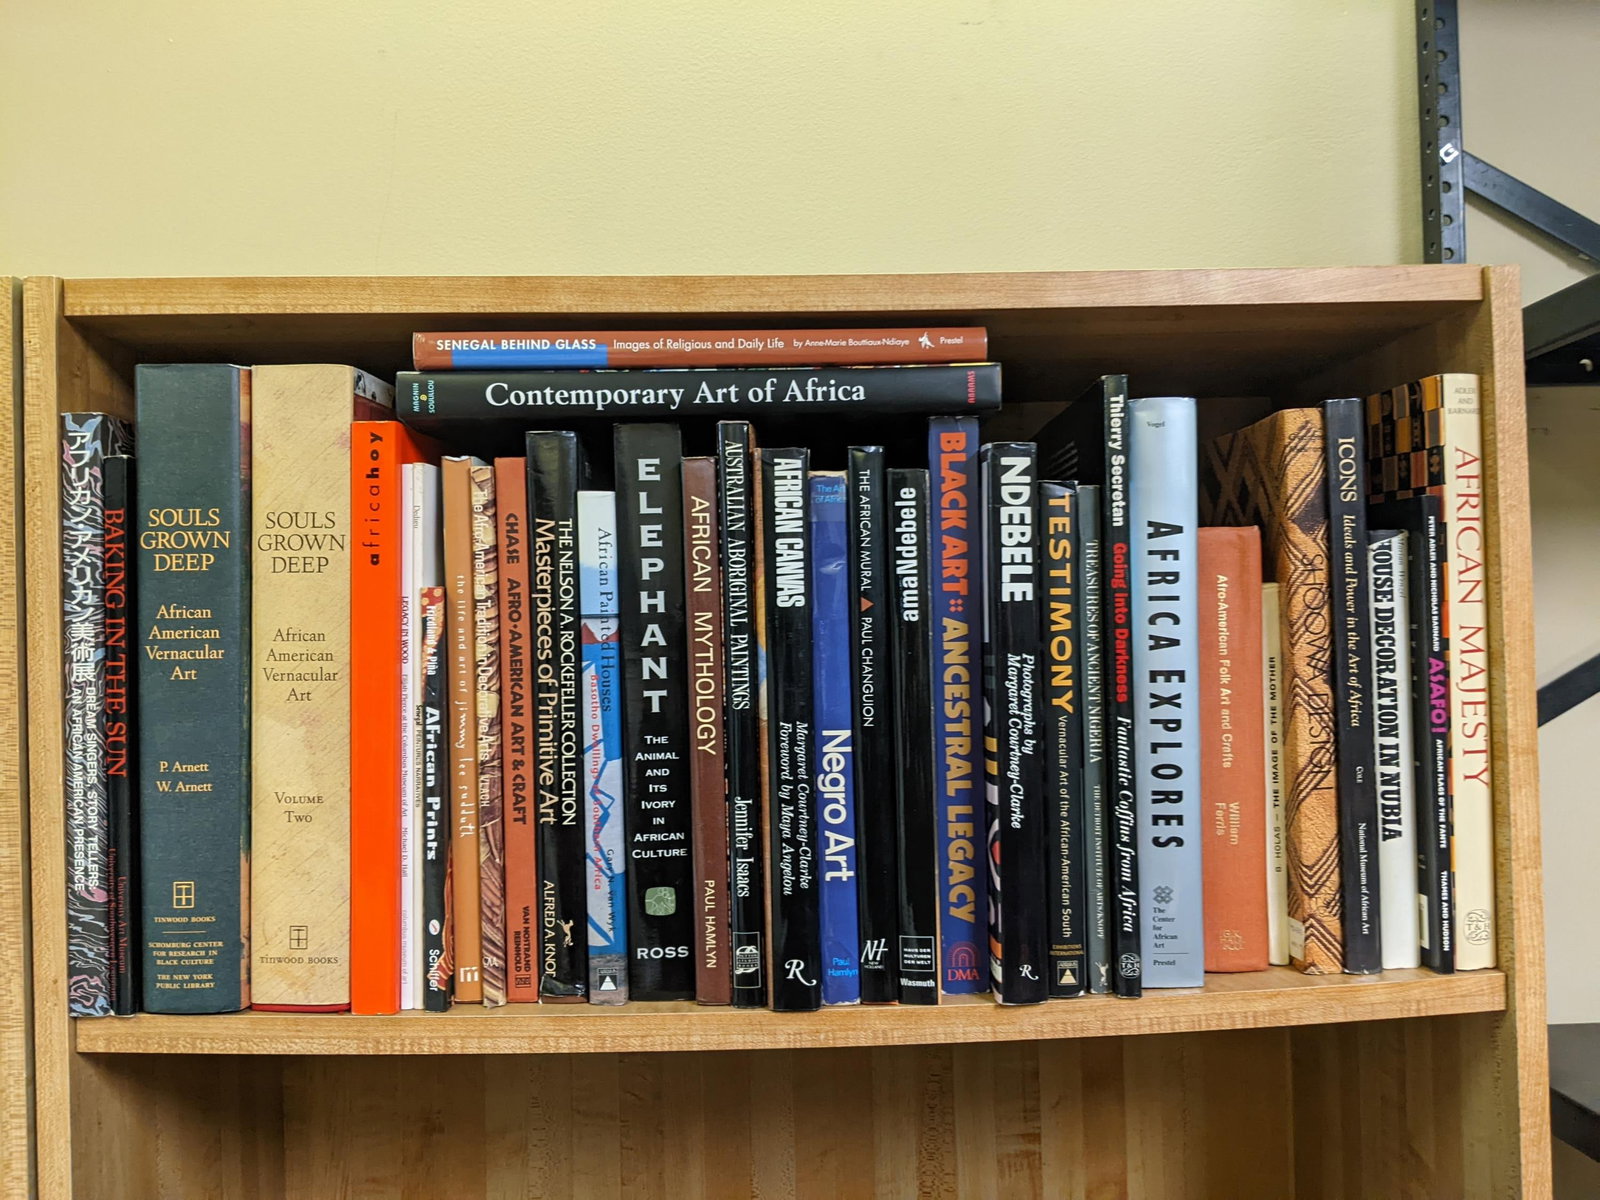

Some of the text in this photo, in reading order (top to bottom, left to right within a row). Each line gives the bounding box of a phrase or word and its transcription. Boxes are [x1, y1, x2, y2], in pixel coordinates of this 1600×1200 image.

[436, 339, 596, 350] SENEGAL BEHIND GLASS
[613, 337, 785, 352] Images of Religious and Daily Life
[793, 337, 910, 348] by Anne-Marie Bouttiaux-Ndiaye
[939, 336, 963, 345] Prestel
[412, 382, 420, 413] MAGNIN
[428, 379, 436, 414] SOULILLOU
[485, 377, 866, 410] Contemporary Art of Africa
[941, 431, 967, 531] BLACK
[1108, 394, 1127, 527] Thierry Secretan
[1338, 437, 1357, 503] ICONS
[148, 508, 220, 527] SOULS
[265, 511, 336, 529] SOULS
[362, 430, 384, 567] africahoy
[140, 531, 231, 549] GROWN
[257, 534, 346, 552] GROWN
[505, 512, 519, 565] CHASE
[773, 457, 806, 607] AFRICAN CANVAS
[859, 468, 872, 591] THE AFRICAN MURAL
[999, 456, 1033, 602] NDEBELE
[1455, 445, 1483, 604] AFRICAN
[154, 553, 215, 572] DEEP
[271, 556, 329, 574] DEEP
[725, 440, 751, 710] AUSTRALIAN ABORIGINAL PAINTINGS
[895, 487, 919, 622] amaNdebele
[637, 457, 668, 713] ELEPHANT
[1048, 492, 1074, 714] TESTIMONY
[148, 626, 220, 640] American
[156, 604, 212, 619] African
[597, 527, 615, 712] African Painted Houses
[691, 494, 716, 755] AFRICAN MYTHOLOGY
[1109, 542, 1130, 702] Going Into Darkness
[1343, 513, 1363, 728] Ideals and Power in the Art of Africa
[104, 507, 128, 777] BAKING IN THE SUN
[146, 646, 225, 660] Vernacular
[265, 648, 334, 662] American
[273, 628, 326, 643] African
[170, 666, 197, 680] Art
[262, 668, 338, 683] Vernacular
[286, 688, 312, 702] Art
[531, 518, 559, 825] Masterpieces of Primitive Art
[559, 518, 576, 825] THE NELSON A. ROCKEFELLER COLLECTION
[861, 617, 874, 727] PAUL CHANGUION
[1147, 519, 1187, 850] AFRICA EXPLORES
[1218, 659, 1231, 685] Folk
[1374, 606, 1399, 740] DECORATION
[1429, 656, 1448, 733] ASAFO!
[943, 616, 971, 797] ANCESTRAL
[1219, 688, 1231, 705] Art
[1221, 709, 1232, 729] and
[1456, 624, 1489, 789] MAJESTY
[511, 721, 525, 756] ART
[1222, 733, 1233, 769] Crafts
[1379, 743, 1400, 769] IN
[86, 687, 100, 890] DREAM SINGERS, STORY TELLERS:
[156, 781, 213, 793] W. Arnett
[159, 761, 209, 773] P. Arnett
[425, 706, 441, 860] African Prints
[512, 759, 525, 771] &
[645, 768, 670, 776] AND
[274, 791, 324, 804] VOLUME
[512, 774, 527, 825] CRAFT
[795, 721, 811, 889] Margaret Courtney-Clarke
[817, 729, 855, 882] Negro Art
[1380, 771, 1403, 842] NUBIA
[1436, 738, 1447, 849] AFRICAN FLAGS OF THE FANTE
[653, 817, 665, 825] IN
[1058, 715, 1073, 938] Vernacular Art of the African-American South
[1115, 716, 1138, 933] Fantastic Coffins from Africa
[734, 796, 754, 897] Jennifer Isaacs
[947, 805, 975, 923] LEGACY
[191, 915, 216, 923] BOOKS
[704, 880, 717, 969] PAUL HAMLYN
[429, 948, 441, 992] Schiffer
[636, 946, 689, 960] ROSS
[948, 968, 980, 981] DMA
[900, 978, 936, 987] Wasmuth
